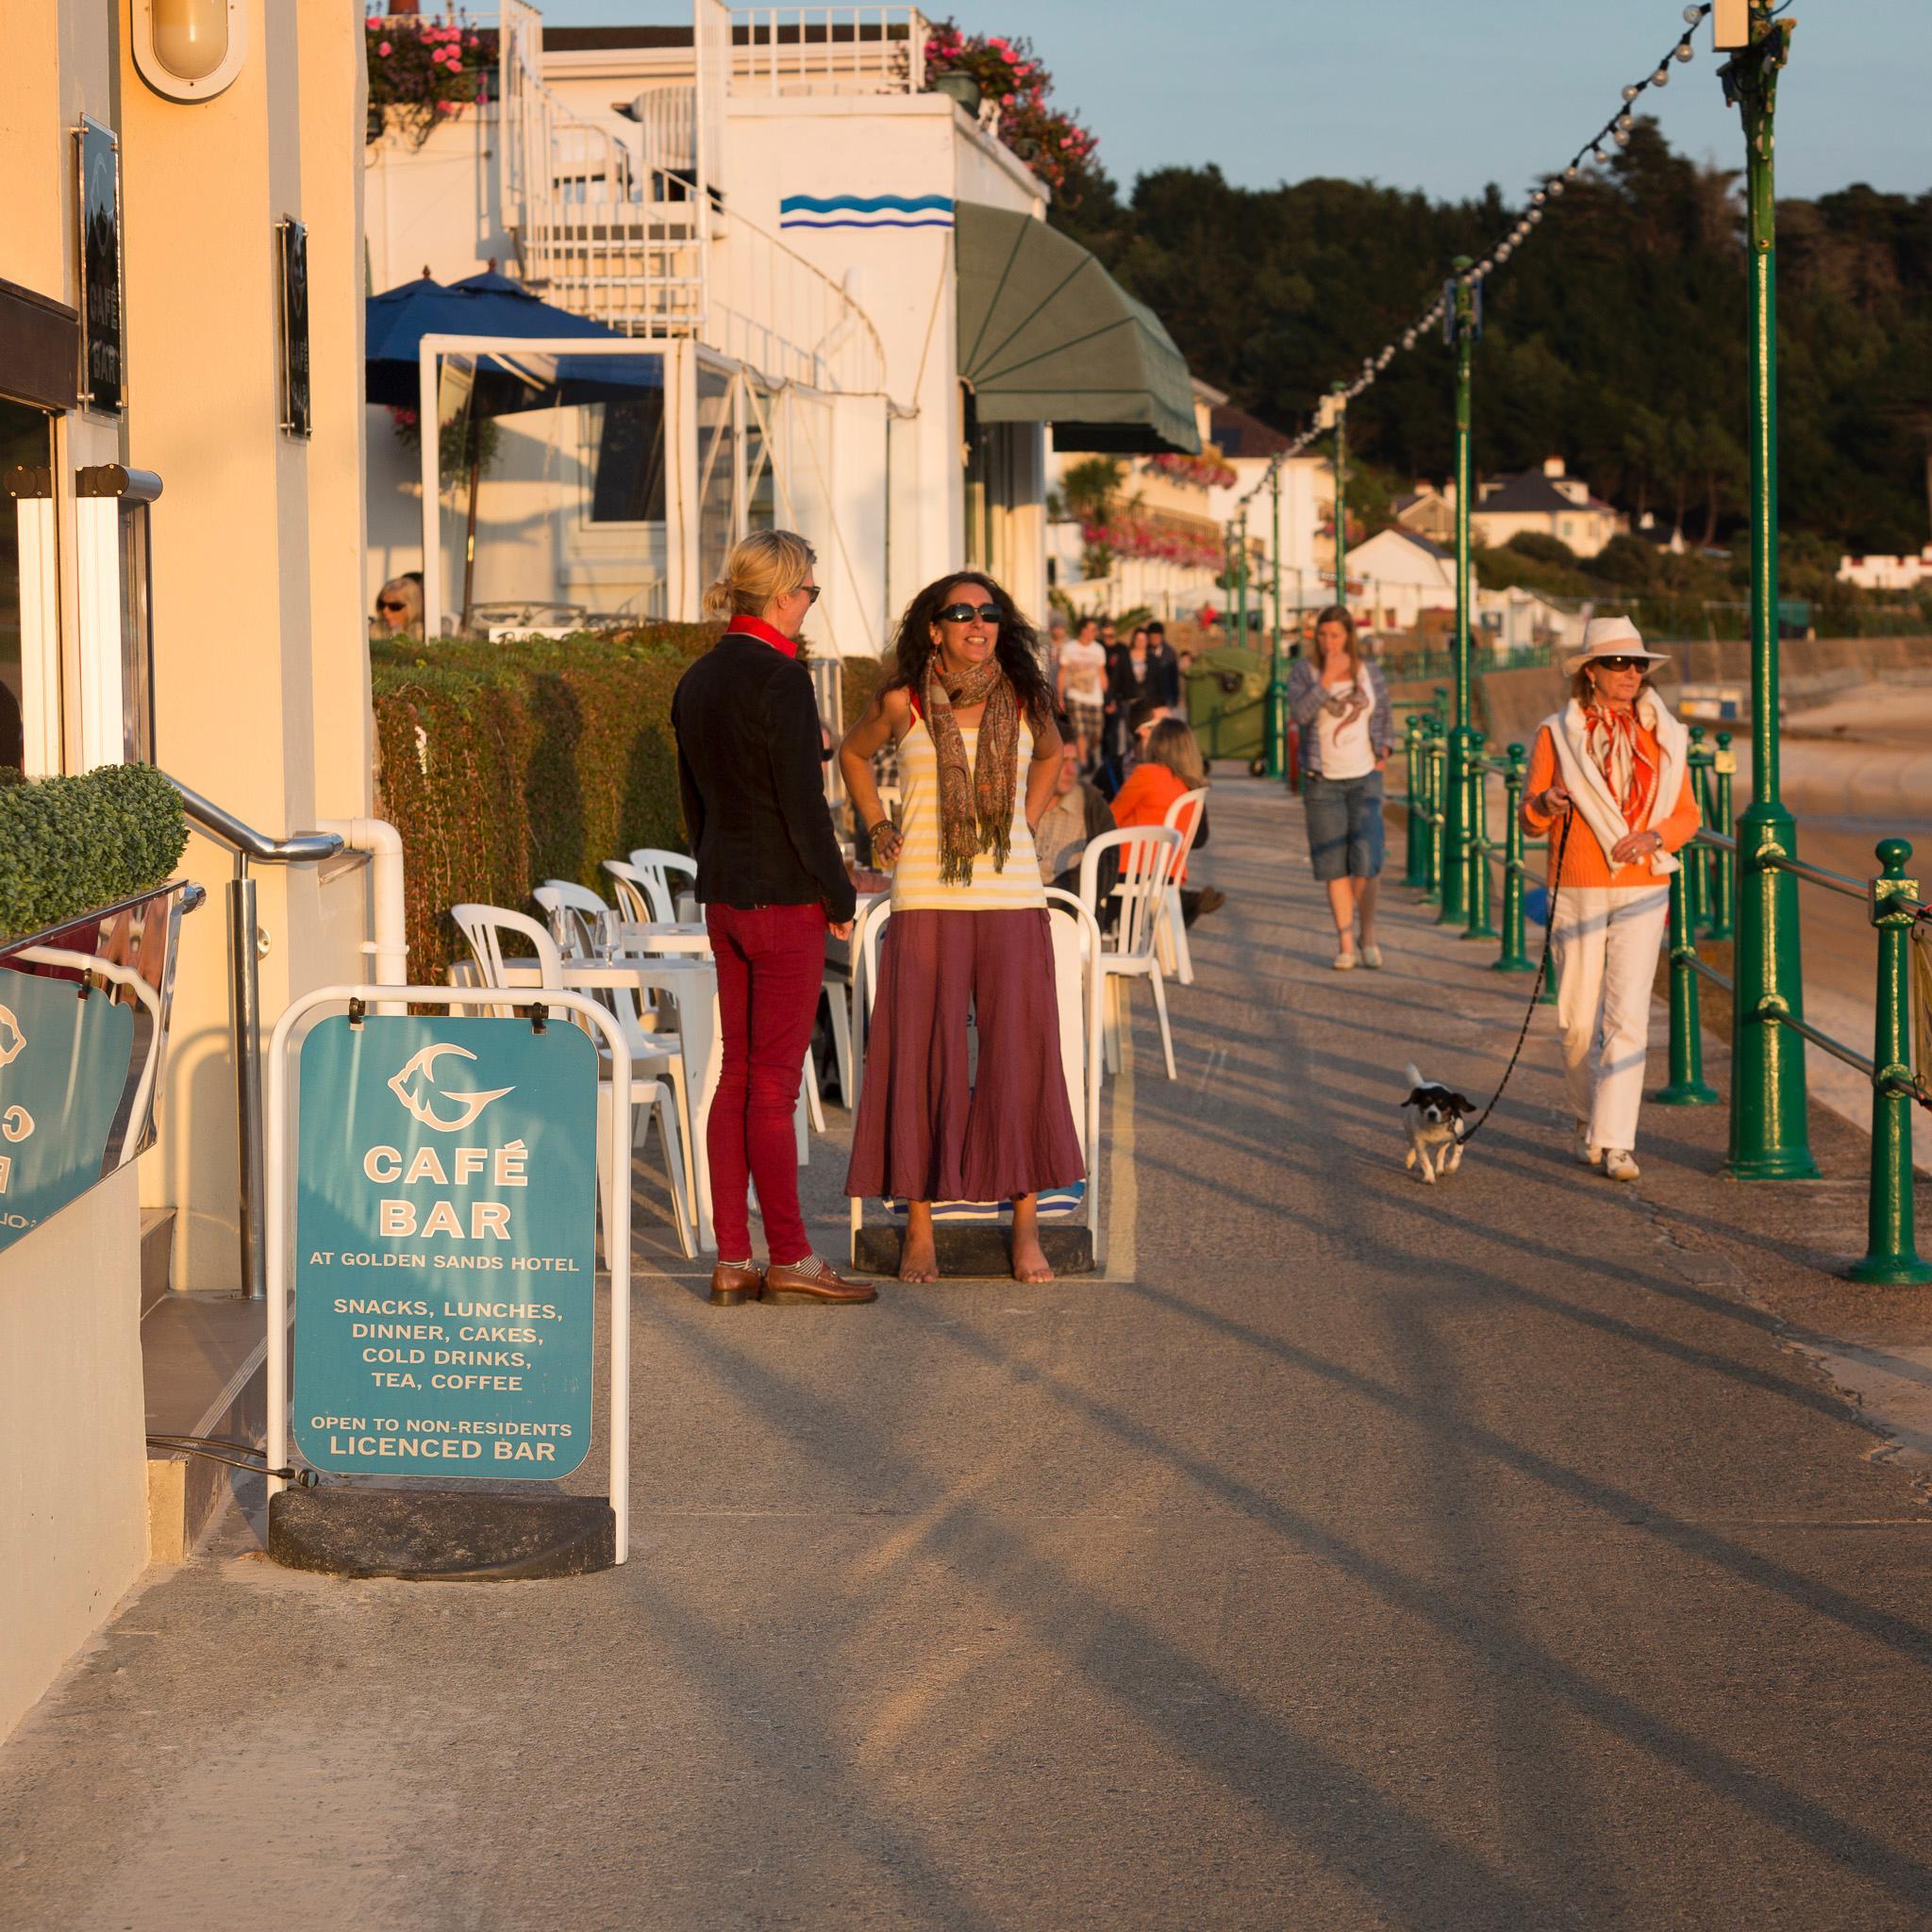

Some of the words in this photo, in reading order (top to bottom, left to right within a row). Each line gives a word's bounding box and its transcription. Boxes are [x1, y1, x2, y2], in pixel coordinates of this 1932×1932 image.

[363, 1139, 528, 1187] CAFÉ
[379, 1199, 511, 1241] BAR
[309, 1252, 334, 1265] AT
[341, 1252, 426, 1269] GOLDEN
[433, 1255, 504, 1270] SANDS
[510, 1257, 580, 1272] HOTEL
[333, 1298, 435, 1318] SNACKS,
[444, 1301, 563, 1322] LUNCHES,
[352, 1324, 450, 1342] DINNER,
[459, 1326, 543, 1345] CAKES,
[362, 1348, 425, 1364] COLD
[434, 1350, 532, 1370] DRINKS,
[372, 1373, 422, 1391] TEA,
[431, 1374, 523, 1391] COFFEE
[310, 1416, 366, 1431] OPEN
[374, 1418, 400, 1432] TO
[407, 1420, 573, 1437] NON-RESIDENTS
[329, 1436, 482, 1459] LICENCED
[493, 1440, 557, 1461] BAR
